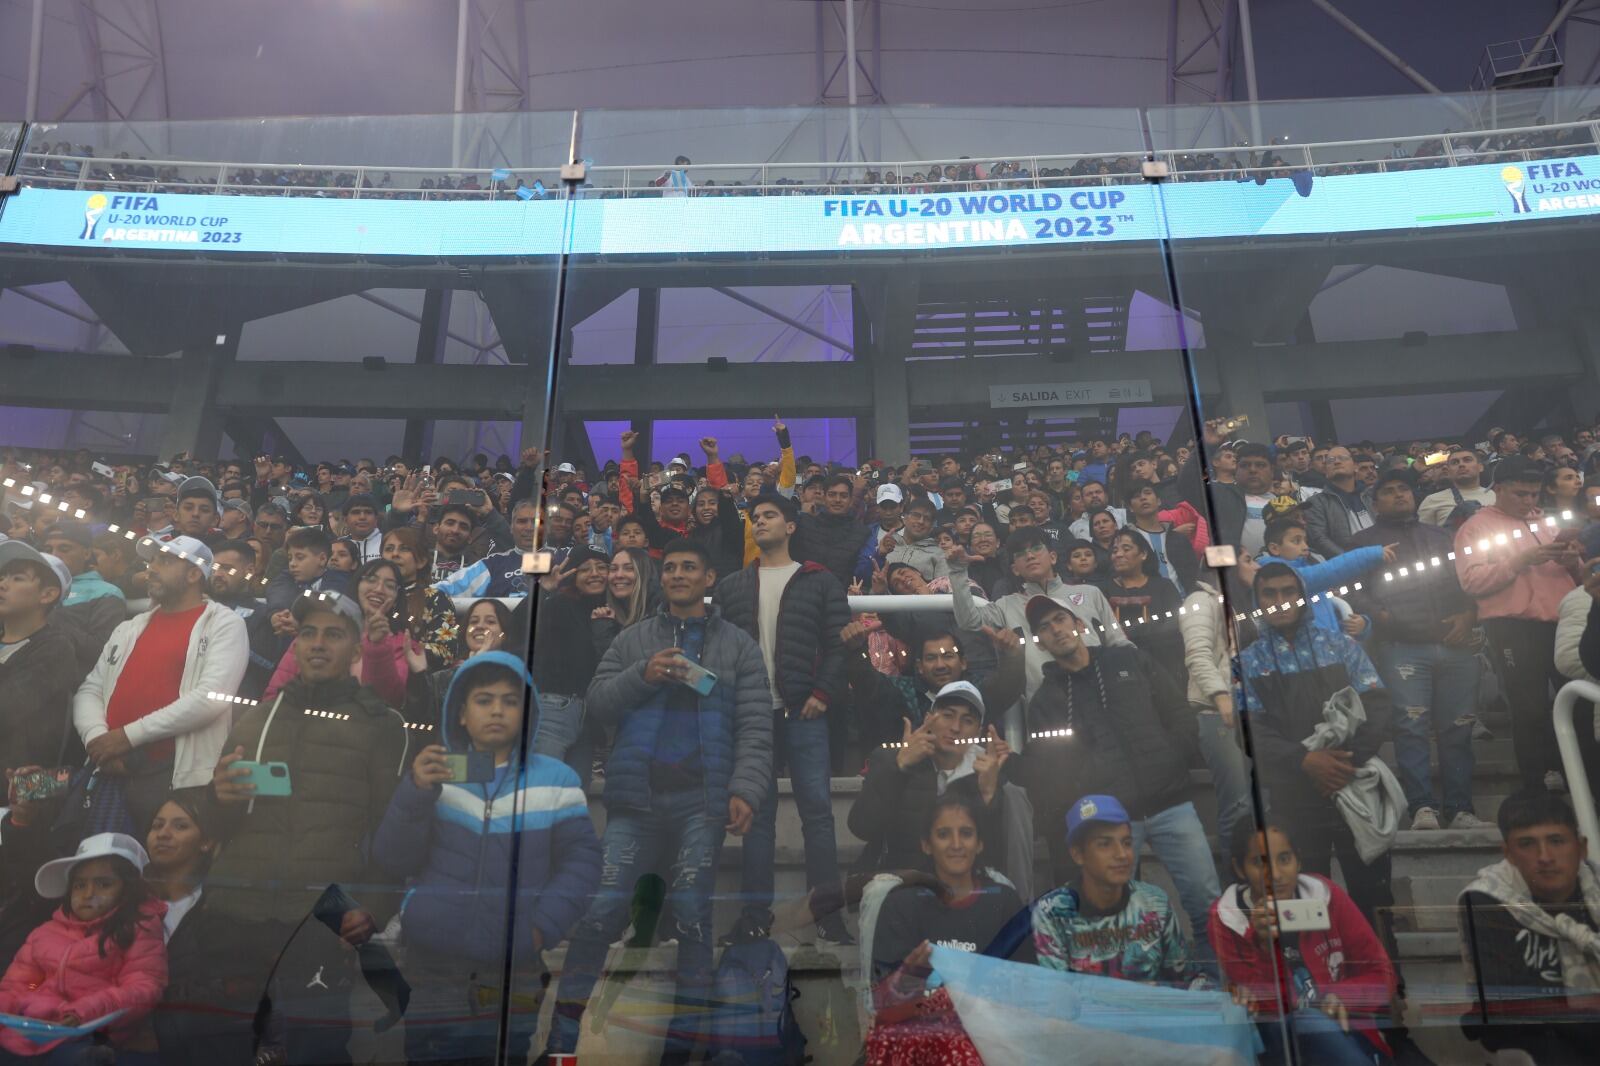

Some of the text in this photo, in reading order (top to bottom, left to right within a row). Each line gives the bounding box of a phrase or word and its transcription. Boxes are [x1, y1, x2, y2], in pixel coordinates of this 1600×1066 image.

[1526, 162, 1584, 180] FIFA
[1533, 182, 1570, 193] U-20
[111, 195, 158, 211] FIFA
[824, 190, 1126, 217] FIFA U-20 WORLD CUP
[108, 213, 229, 227] U-20 WORLD CUP
[103, 227, 242, 243] ARGENTINA 2023
[837, 218, 1028, 246] ARGENTINA
[1034, 215, 1114, 239] 2023
[1012, 389, 1092, 402] SALIDA EXIT
